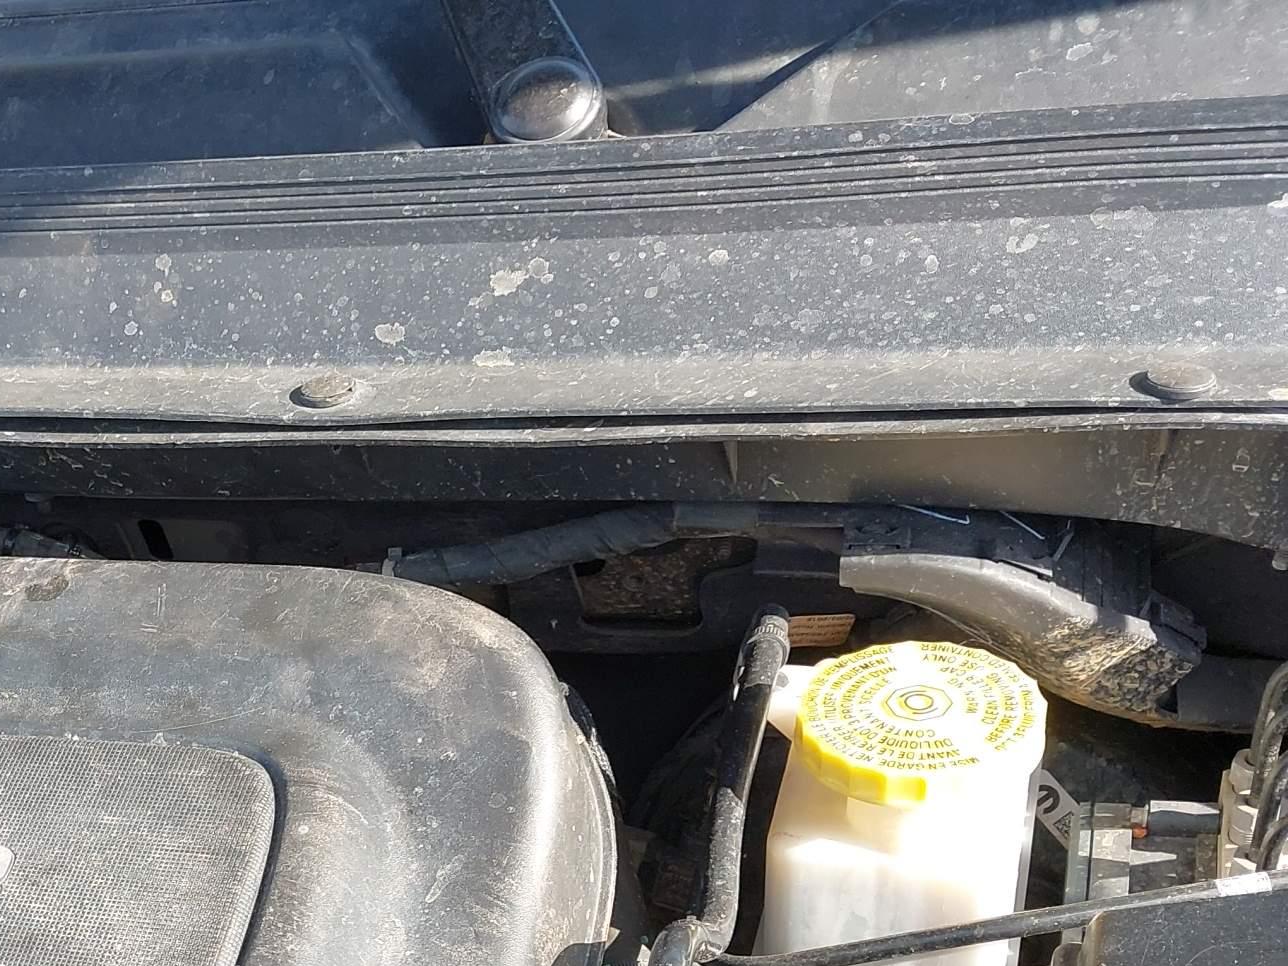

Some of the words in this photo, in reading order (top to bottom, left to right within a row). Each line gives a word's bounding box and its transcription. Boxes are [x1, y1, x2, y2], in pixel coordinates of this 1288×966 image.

[921, 644, 989, 661] CONTAINER
[923, 654, 957, 664] ONLY
[940, 664, 966, 675] CAP
[947, 677, 978, 713] WARNNG
[981, 699, 997, 725] CLEAN
[853, 726, 877, 739] DOT
[985, 714, 1016, 742] BEFORE
[878, 736, 930, 749] LIQUIDE
[934, 737, 953, 748] DU
[877, 747, 894, 756] LE
[898, 751, 914, 759] DE
[918, 749, 960, 760] AVANT
[929, 761, 946, 769] EN
